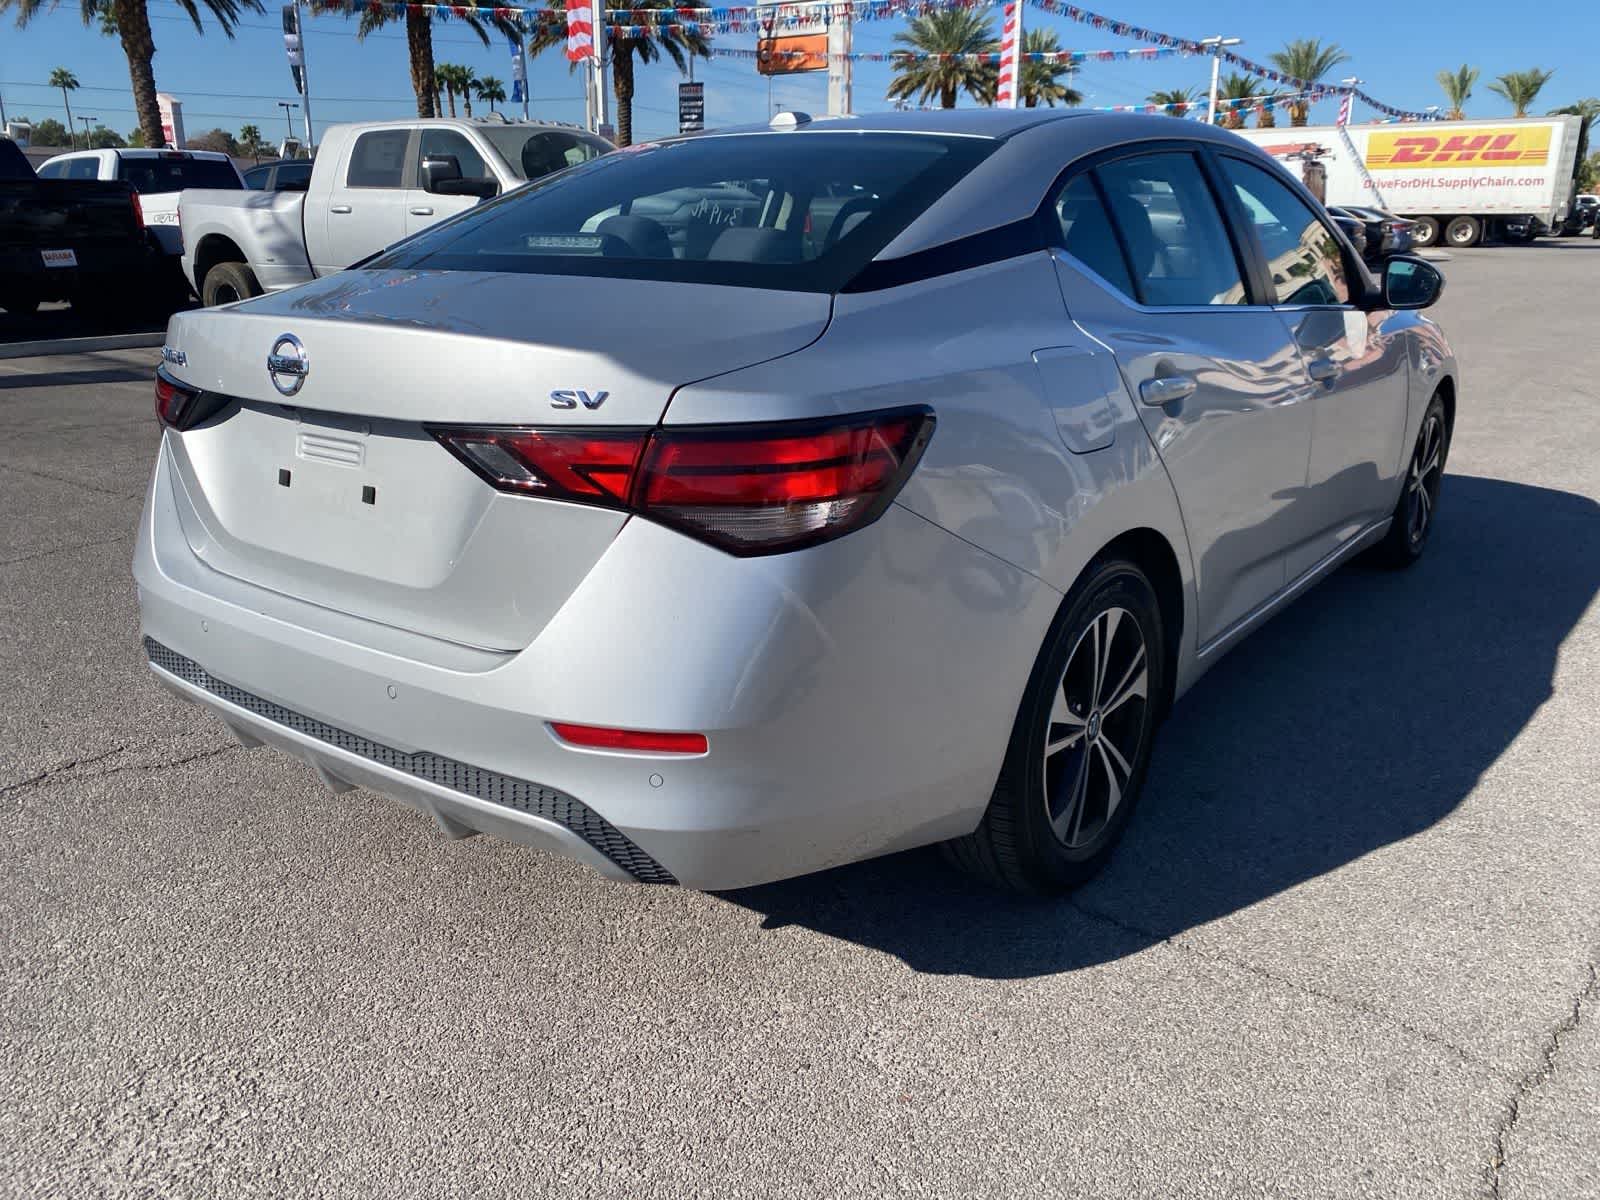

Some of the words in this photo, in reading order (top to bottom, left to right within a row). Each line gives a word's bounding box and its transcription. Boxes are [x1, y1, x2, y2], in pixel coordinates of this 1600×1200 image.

[1388, 134, 1522, 163] DHL
[1363, 176, 1545, 190] DiveForDHLSupplyChain.com
[550, 390, 609, 410] SV
